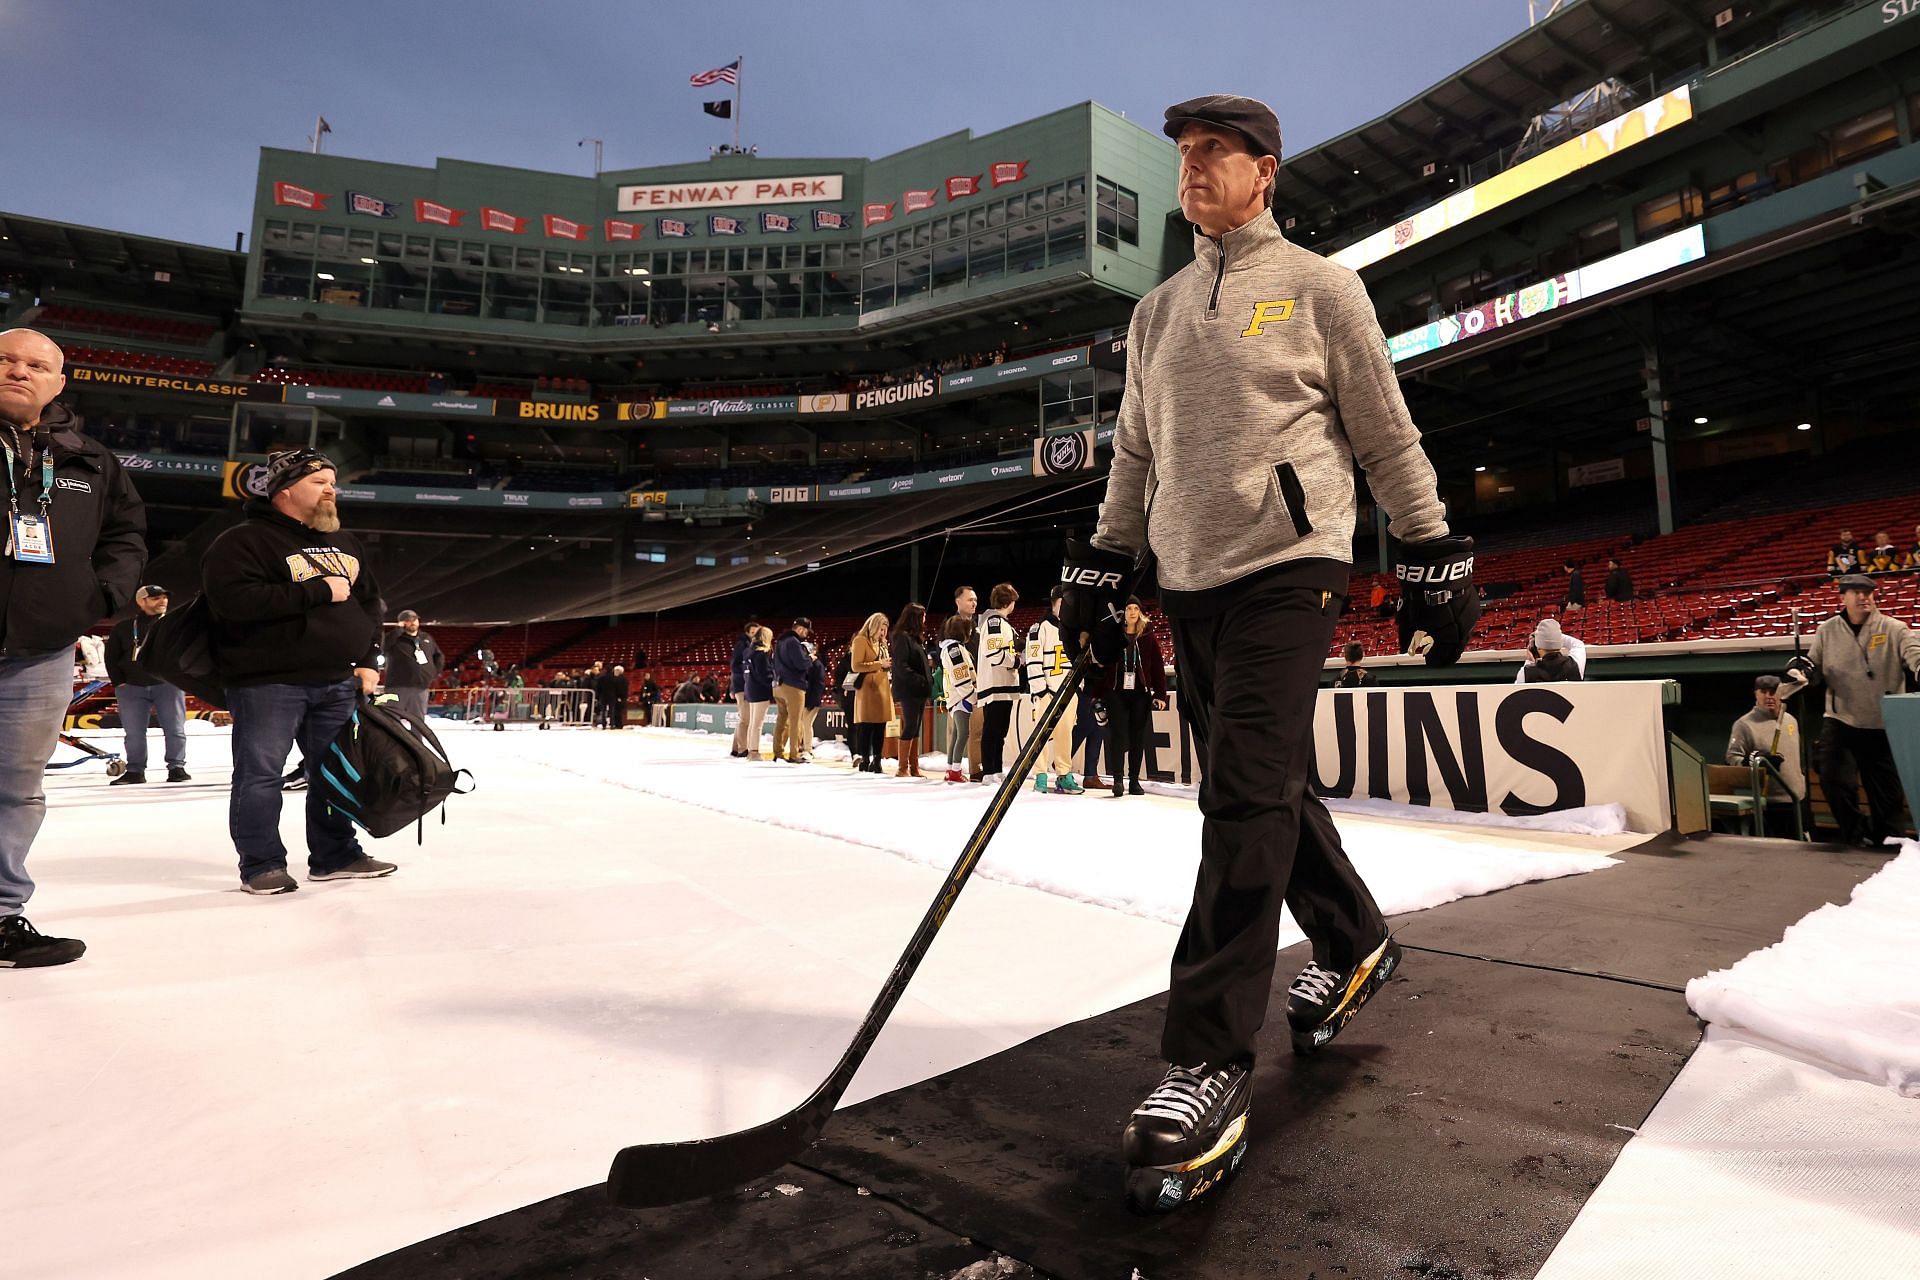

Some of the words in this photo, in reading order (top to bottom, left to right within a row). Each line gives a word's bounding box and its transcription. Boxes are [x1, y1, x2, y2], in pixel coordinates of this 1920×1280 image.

[632, 185, 739, 206] FENWAY
[755, 180, 826, 199] PARK
[1240, 298, 1297, 338] P
[1052, 354, 1078, 366] GEICO
[856, 379, 935, 410] PENGUINS
[519, 401, 599, 421] BRUINS
[709, 400, 754, 416] Winter
[755, 401, 795, 409] CLASSIC
[1056, 444, 1071, 461] NHL
[156, 461, 218, 472] CLASSIC
[771, 488, 807, 501] PIT
[986, 638, 1004, 650] 87
[953, 665, 970, 680] 87
